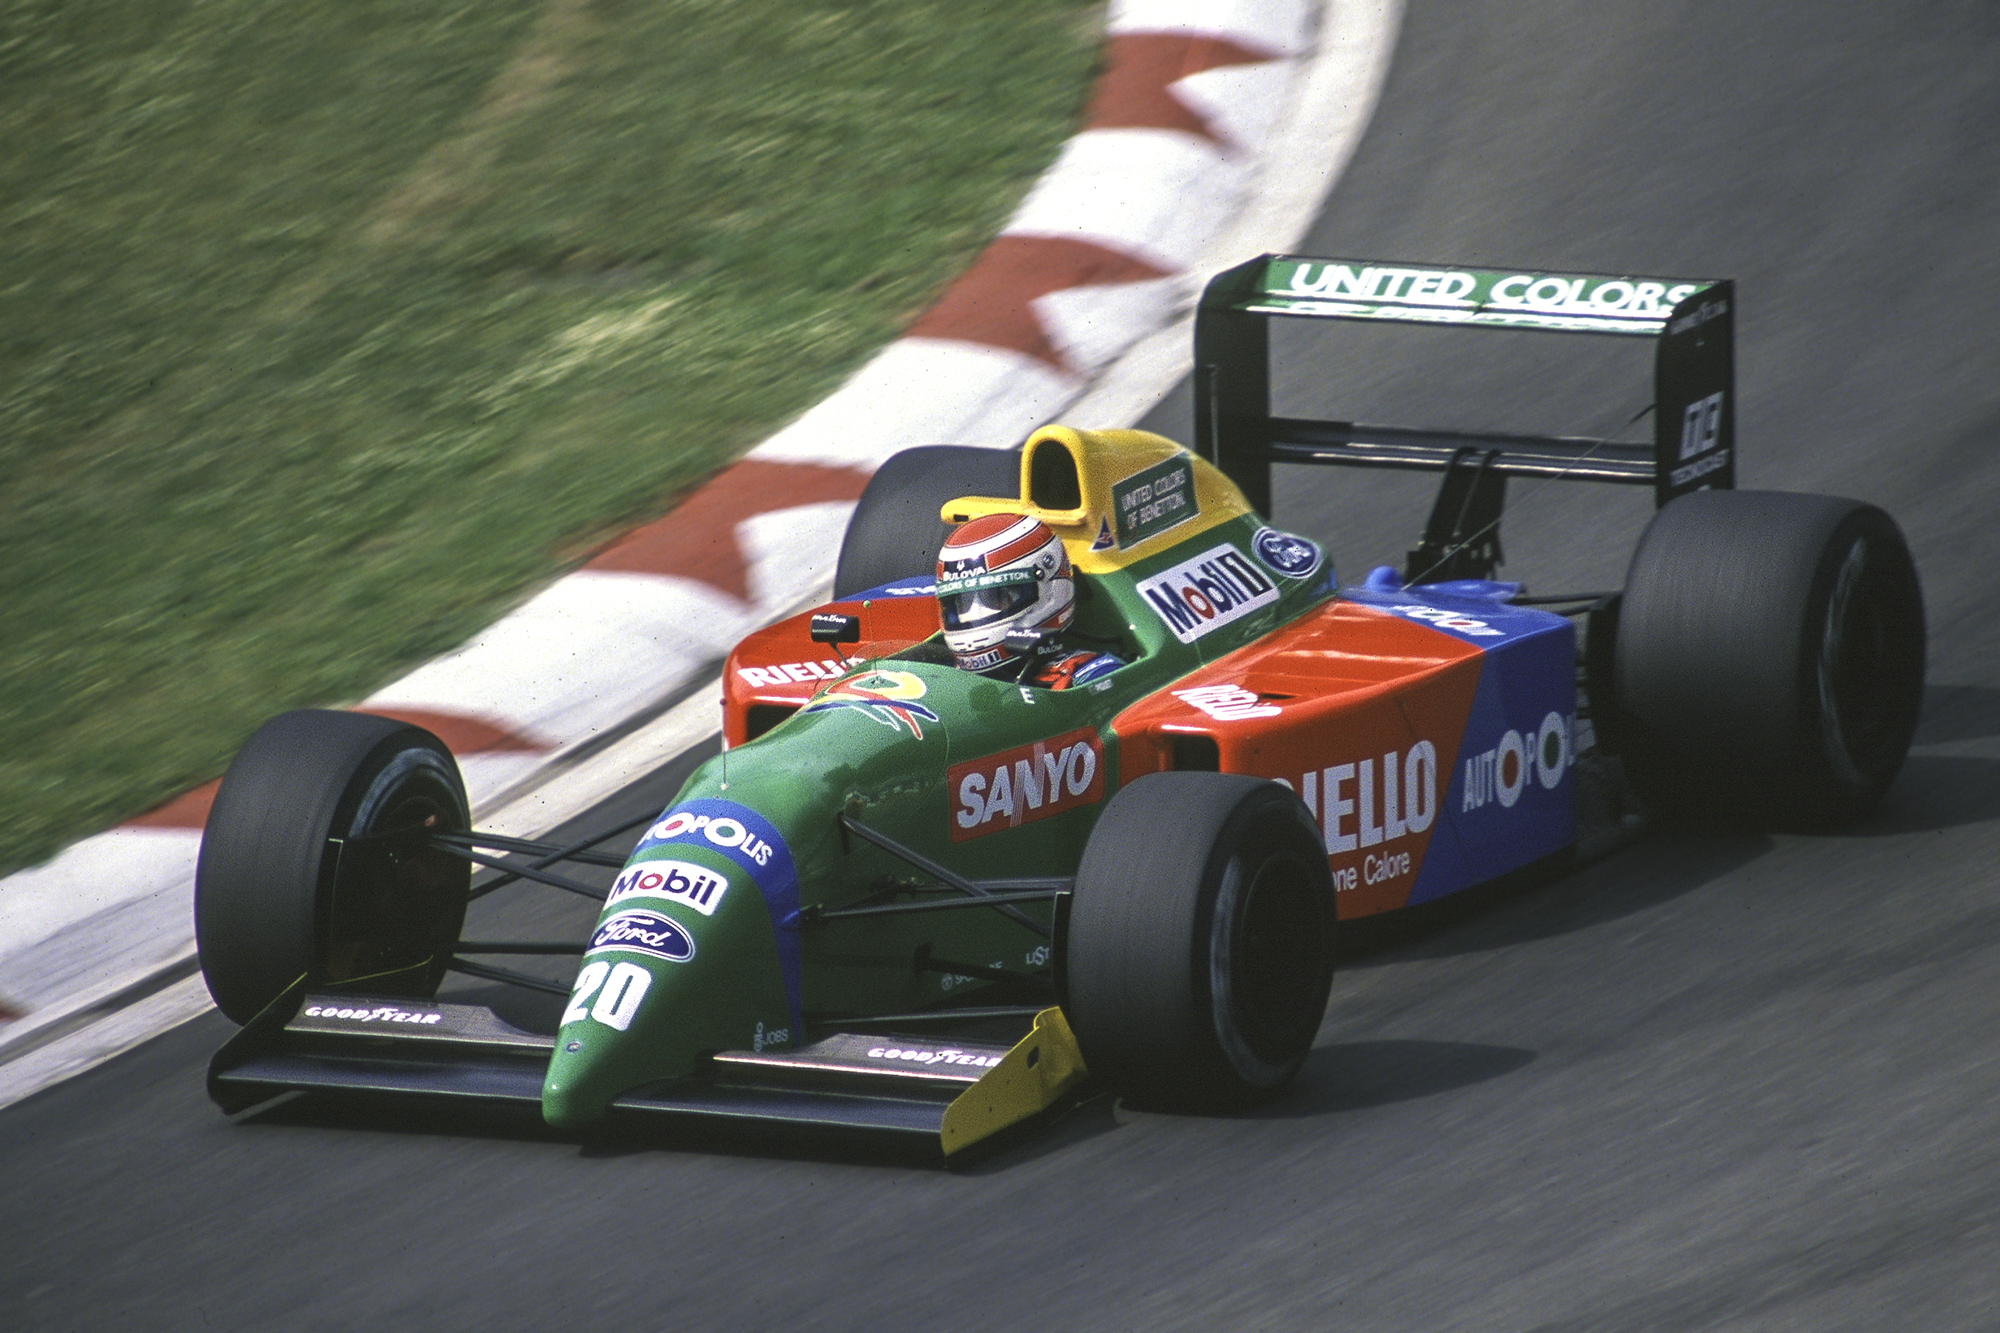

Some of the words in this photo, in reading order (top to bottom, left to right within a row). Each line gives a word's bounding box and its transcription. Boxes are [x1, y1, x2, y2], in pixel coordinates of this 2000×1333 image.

[1291, 263, 1477, 301] UNITED
[1489, 274, 1697, 314] COLORS
[1121, 484, 1152, 510] UNITED
[1154, 467, 1186, 496] COLORS
[1127, 510, 1138, 530] OF
[1140, 490, 1187, 525] BENETTON
[943, 566, 986, 582] BULOVA
[964, 577, 977, 588] OF
[1145, 560, 1250, 635] Mobil
[956, 741, 1097, 829] SANYO
[1272, 740, 1437, 856] IELLO
[610, 868, 719, 906] Mobil
[1363, 850, 1411, 886] Calore
[594, 913, 674, 948] Ford
[304, 1005, 441, 1025] GOODYEAR
[559, 960, 652, 1032] 20
